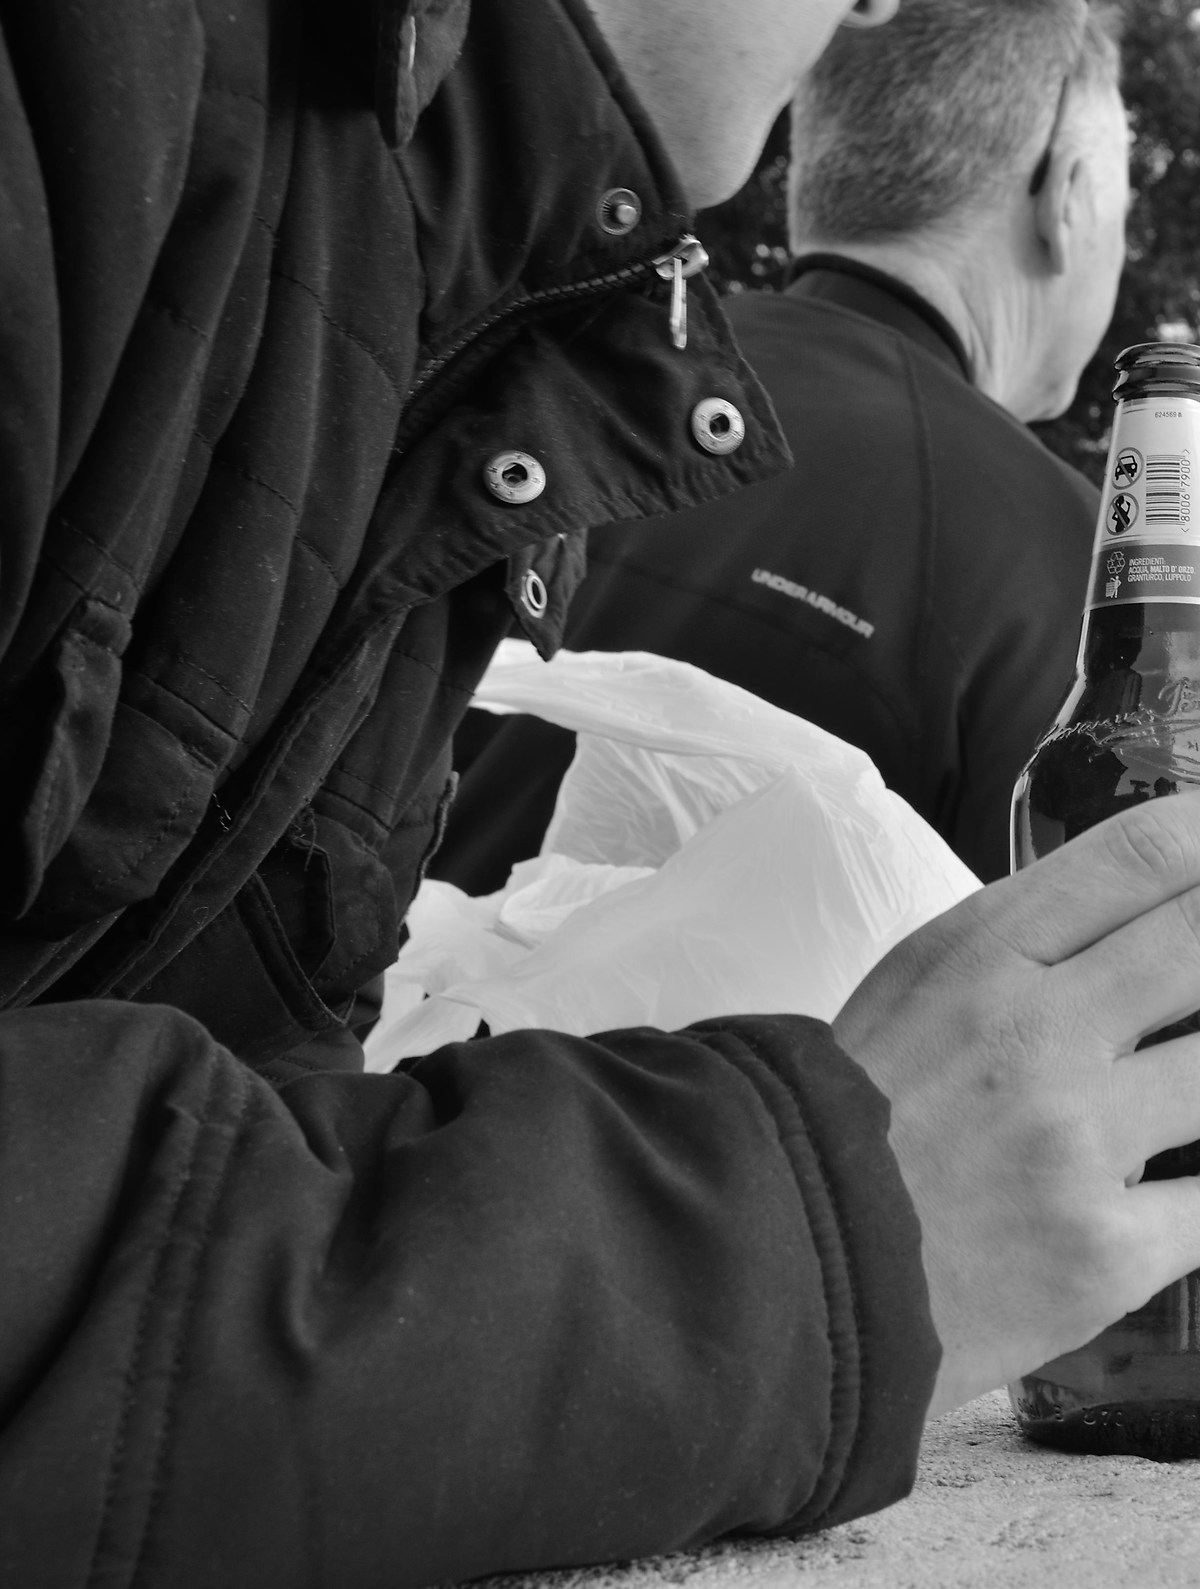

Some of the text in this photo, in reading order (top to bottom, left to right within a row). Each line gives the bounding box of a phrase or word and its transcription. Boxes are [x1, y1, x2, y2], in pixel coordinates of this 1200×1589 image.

[1150, 565, 1170, 574] MALTO
[1127, 573, 1192, 583] GRANTURCO, LUPPOLO
